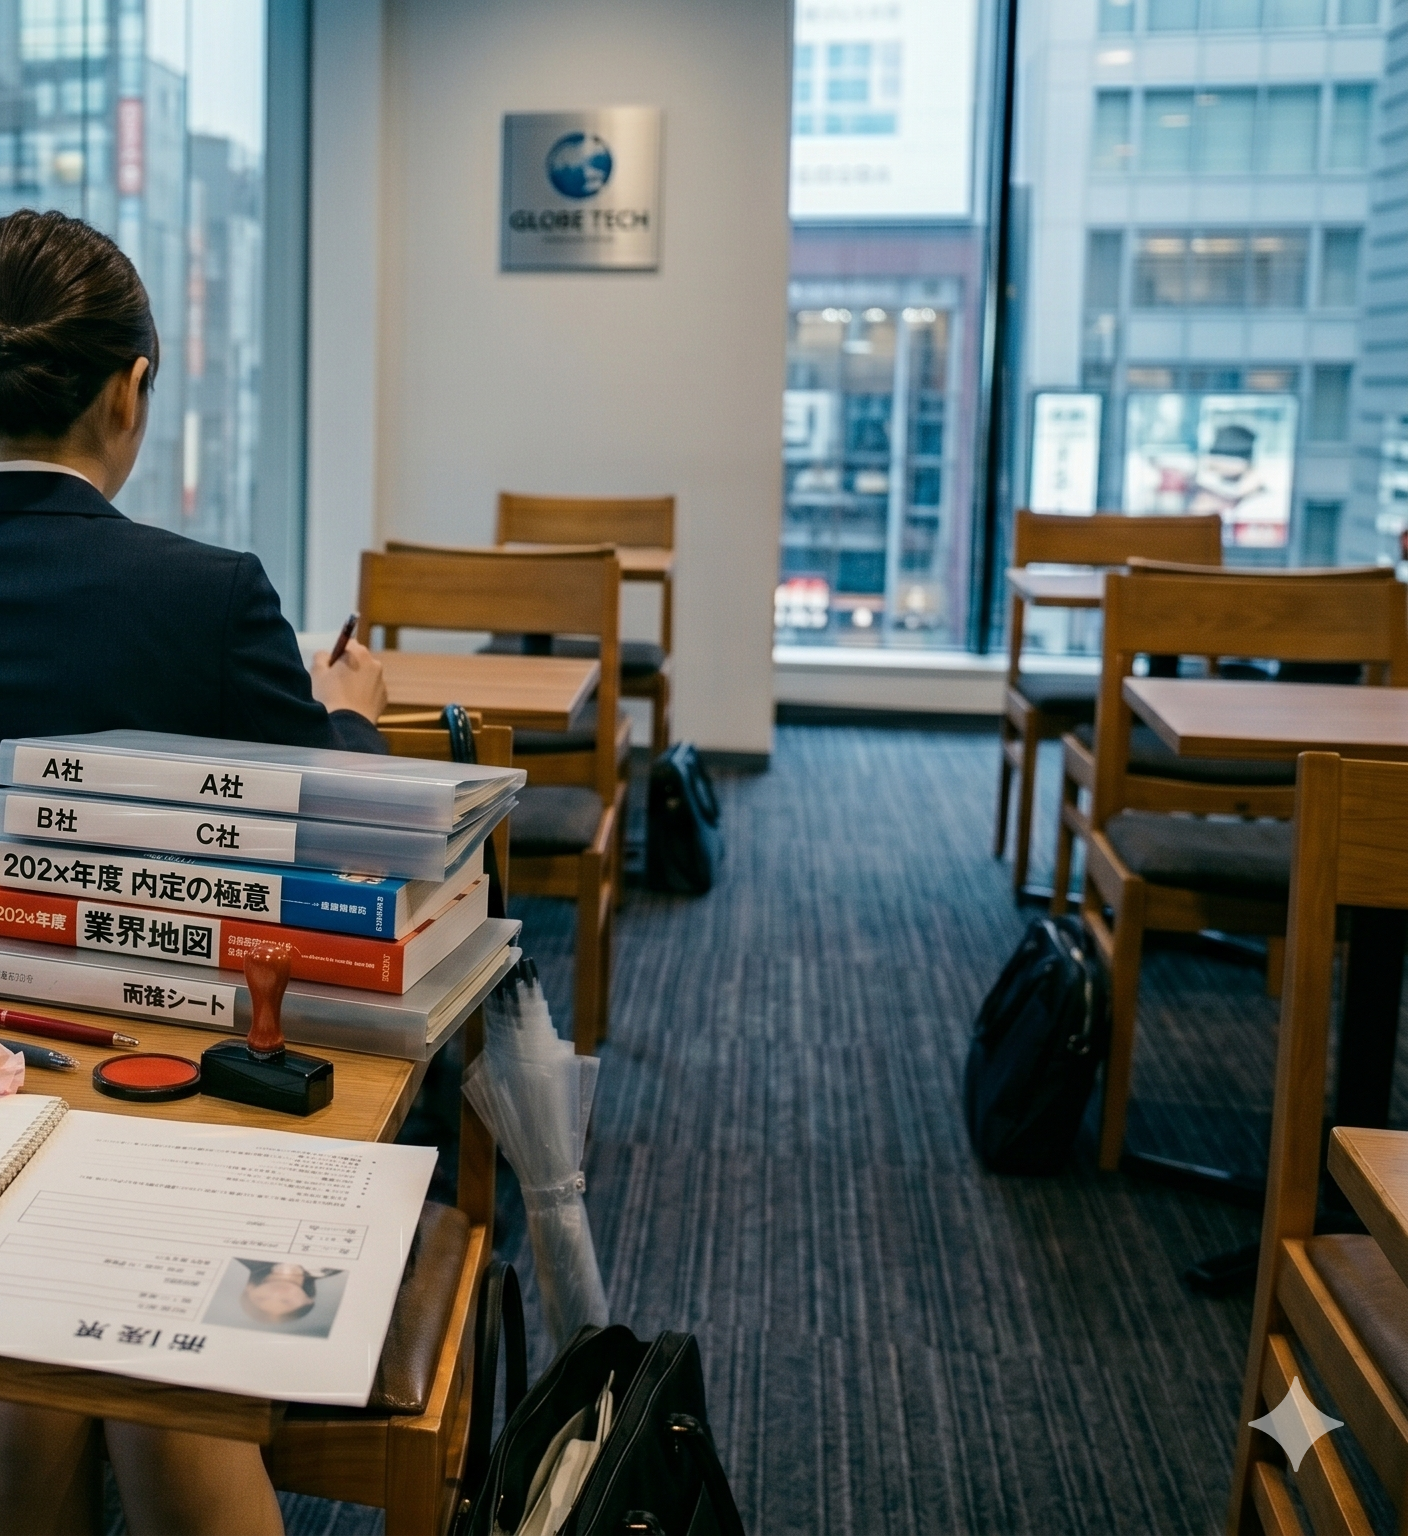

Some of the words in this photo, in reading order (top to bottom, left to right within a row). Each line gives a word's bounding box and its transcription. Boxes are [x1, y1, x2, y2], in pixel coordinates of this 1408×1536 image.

[509, 210, 583, 232] GLOBE
[591, 210, 649, 232] TECH
[41, 757, 84, 783] A社
[199, 773, 244, 799] A社
[37, 806, 78, 833] B社
[196, 822, 240, 849] C社
[3, 853, 124, 894] 202x年度
[131, 868, 271, 912] 内定の極意
[84, 910, 213, 959] 業界地図
